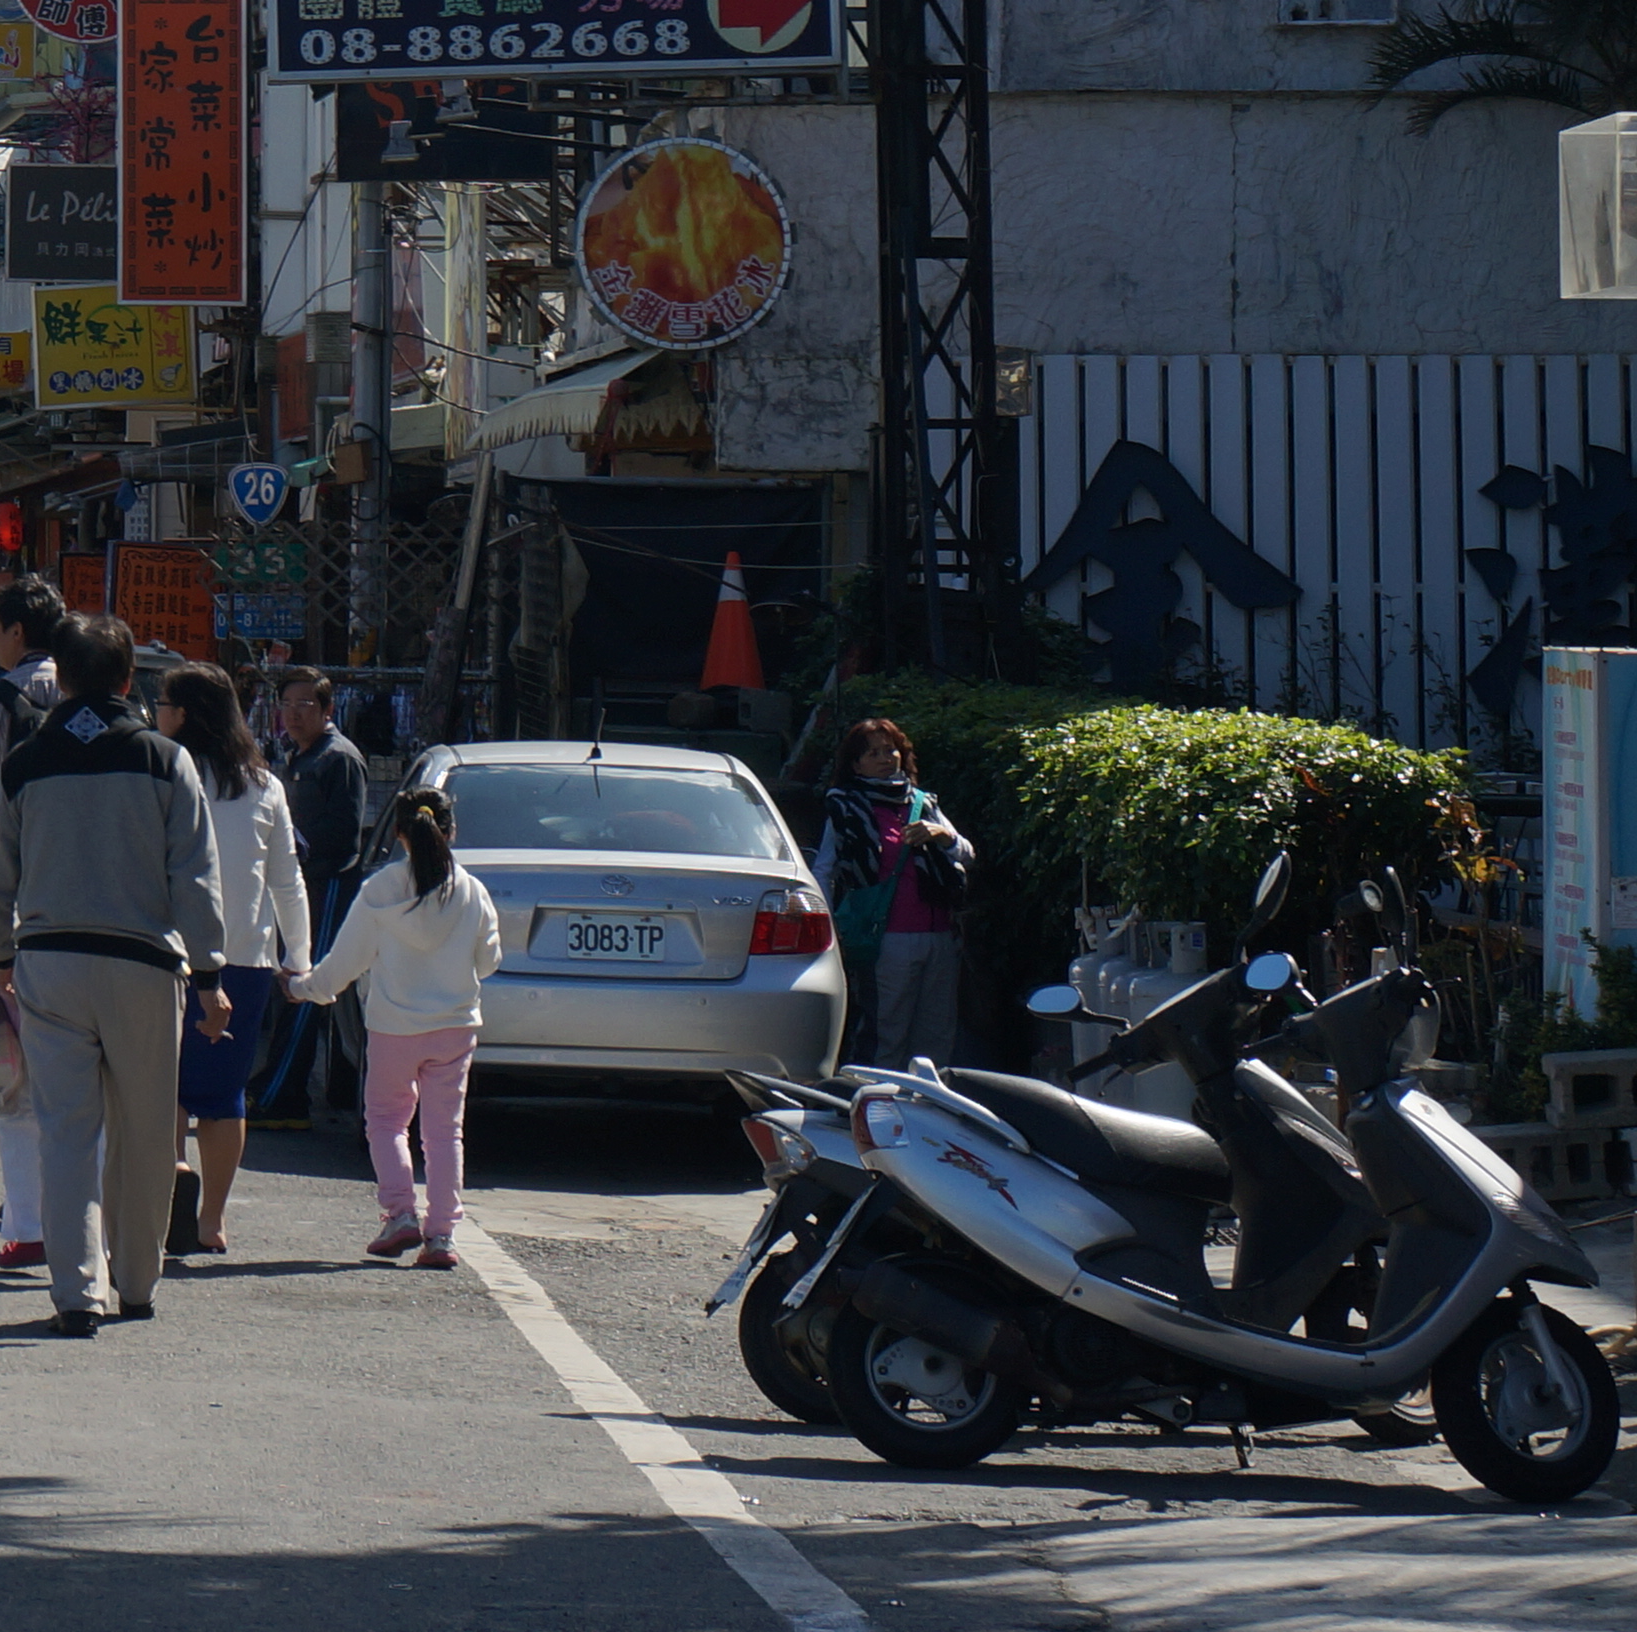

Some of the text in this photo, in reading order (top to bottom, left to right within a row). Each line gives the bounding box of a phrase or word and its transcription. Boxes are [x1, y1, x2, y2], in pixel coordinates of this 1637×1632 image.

[301, 19, 691, 65] 08-8862668
[140, 40, 177, 250] 家常菜
[41, 299, 145, 347] 鮮果汁
[243, 471, 276, 506] 26
